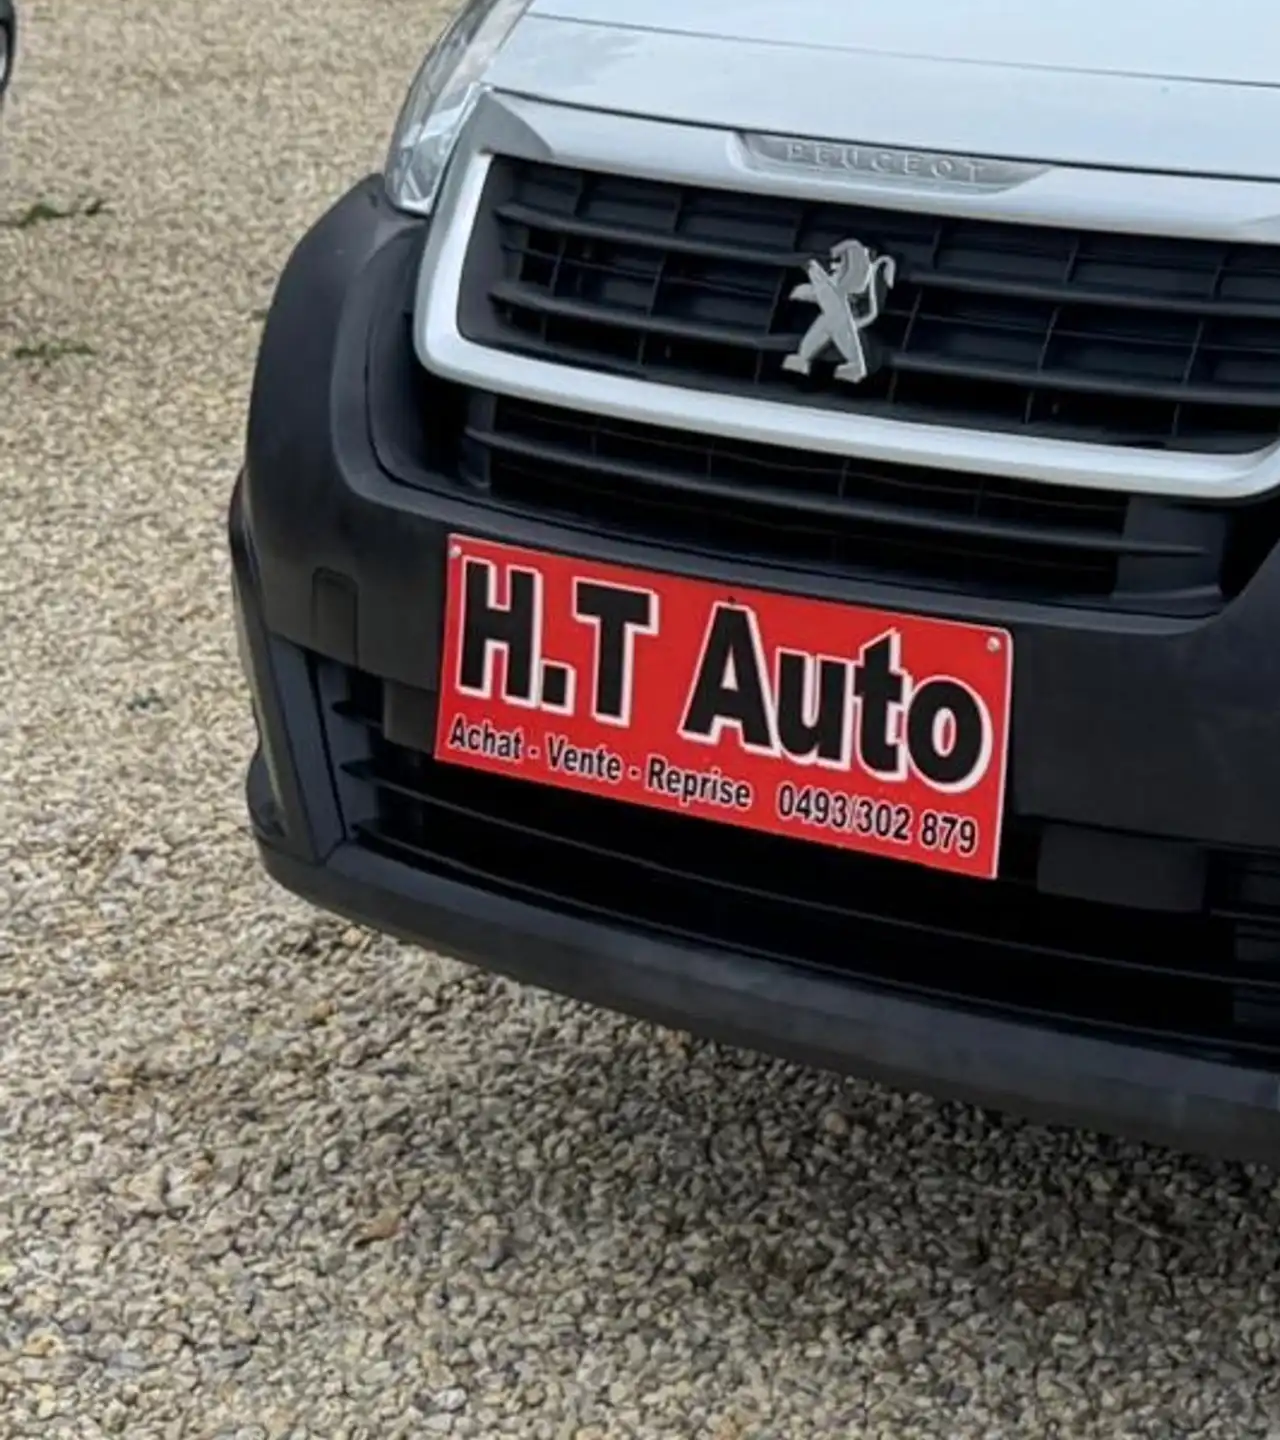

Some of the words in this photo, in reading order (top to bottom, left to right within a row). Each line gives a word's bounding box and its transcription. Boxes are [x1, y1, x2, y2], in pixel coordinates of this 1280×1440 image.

[785, 141, 985, 183] PEUGEOT
[455, 554, 659, 728] H.T
[677, 601, 994, 794] Auto
[448, 712, 524, 762] Achat
[546, 734, 623, 783] Vente
[645, 752, 753, 808] Reprise
[919, 809, 978, 858] 879
